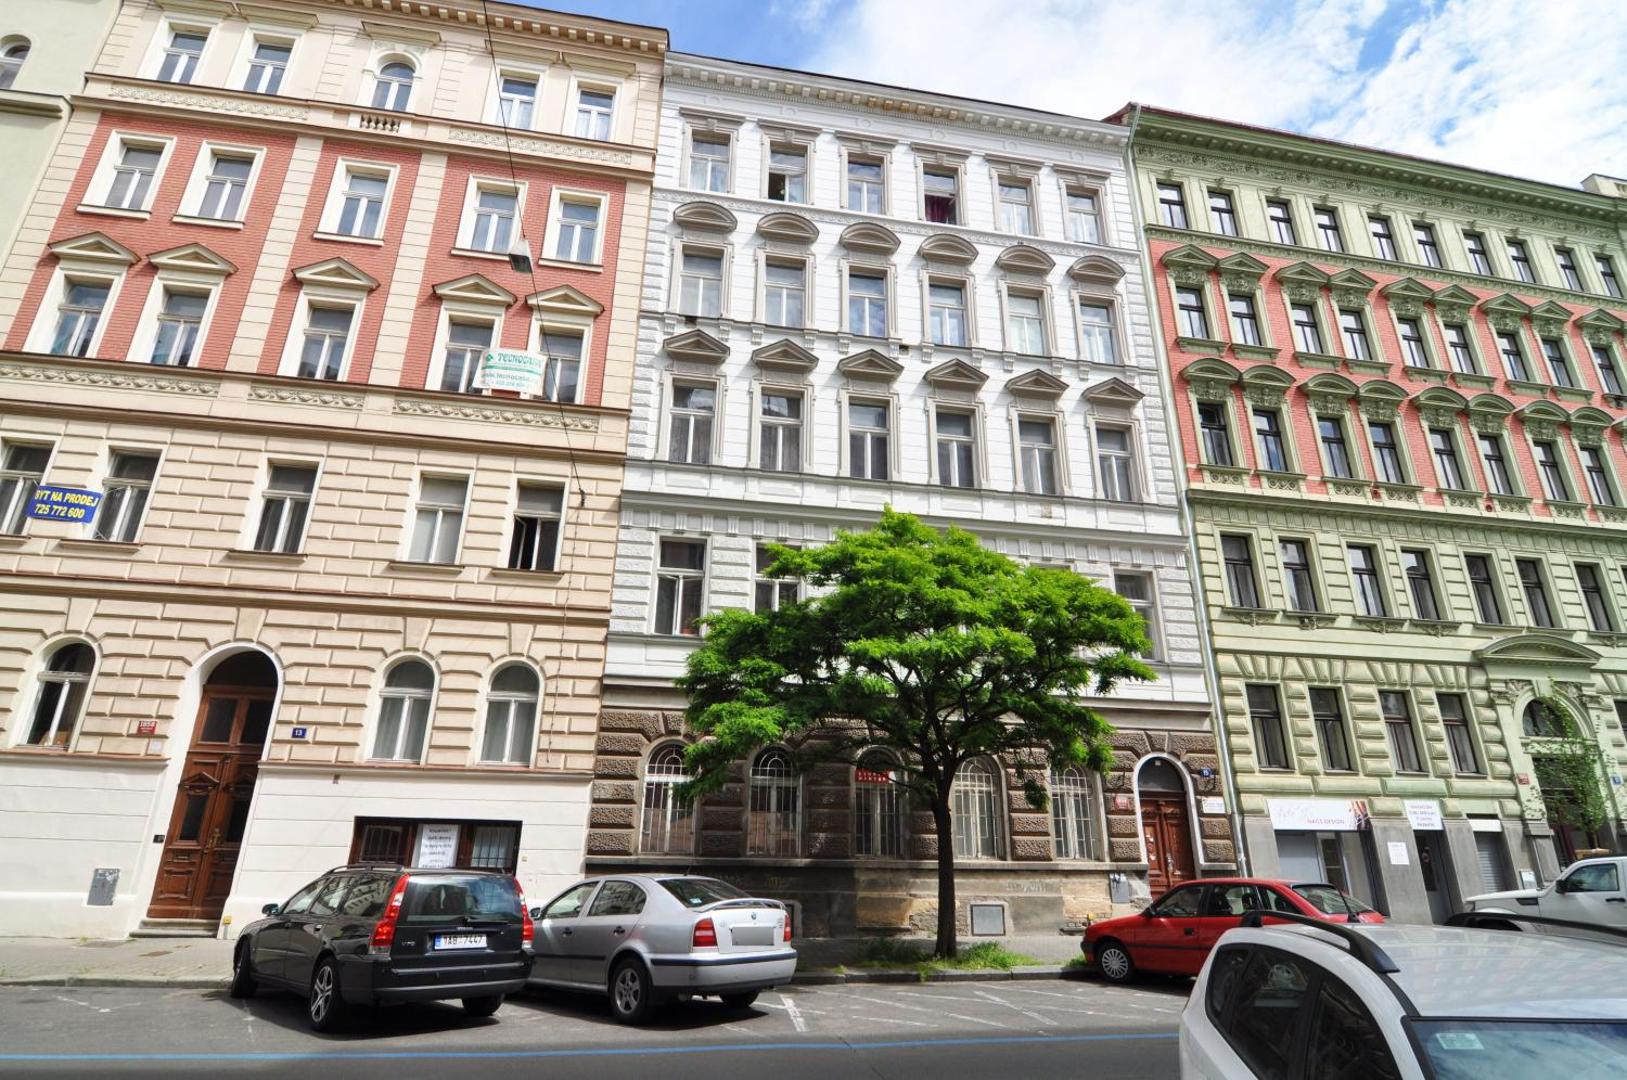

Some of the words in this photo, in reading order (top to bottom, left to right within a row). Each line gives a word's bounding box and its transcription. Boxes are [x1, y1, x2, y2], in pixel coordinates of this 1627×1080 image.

[50, 491, 63, 502] NA
[63, 493, 99, 507] PRODEJ
[34, 504, 51, 515] 725
[51, 505, 68, 517] 772
[67, 507, 86, 518] 600
